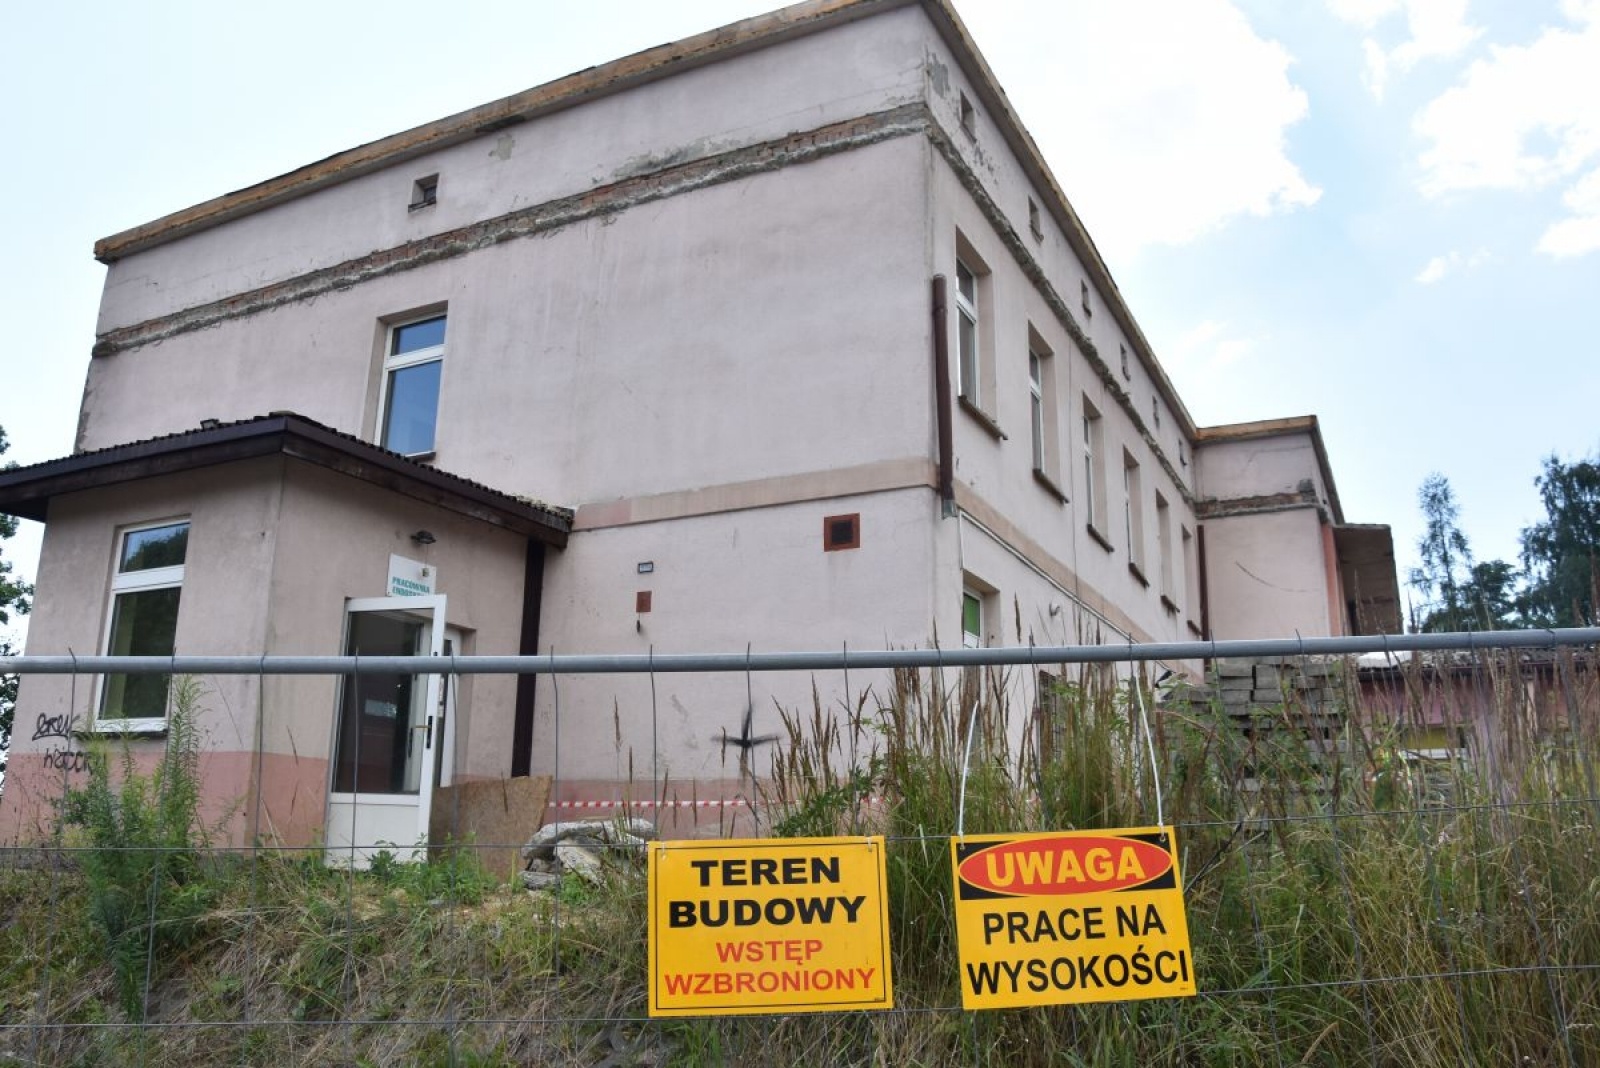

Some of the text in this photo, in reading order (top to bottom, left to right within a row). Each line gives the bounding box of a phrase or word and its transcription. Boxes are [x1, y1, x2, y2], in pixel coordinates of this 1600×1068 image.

[692, 857, 840, 887] TEREN
[986, 846, 1146, 887] UWAGA
[669, 895, 867, 928] BUDOWY
[984, 903, 1166, 945] PRACE NA
[716, 939, 823, 965] WSTĘP
[664, 967, 875, 996] WZBRONIONY
[967, 944, 1189, 996] WYSOKOŚCI
